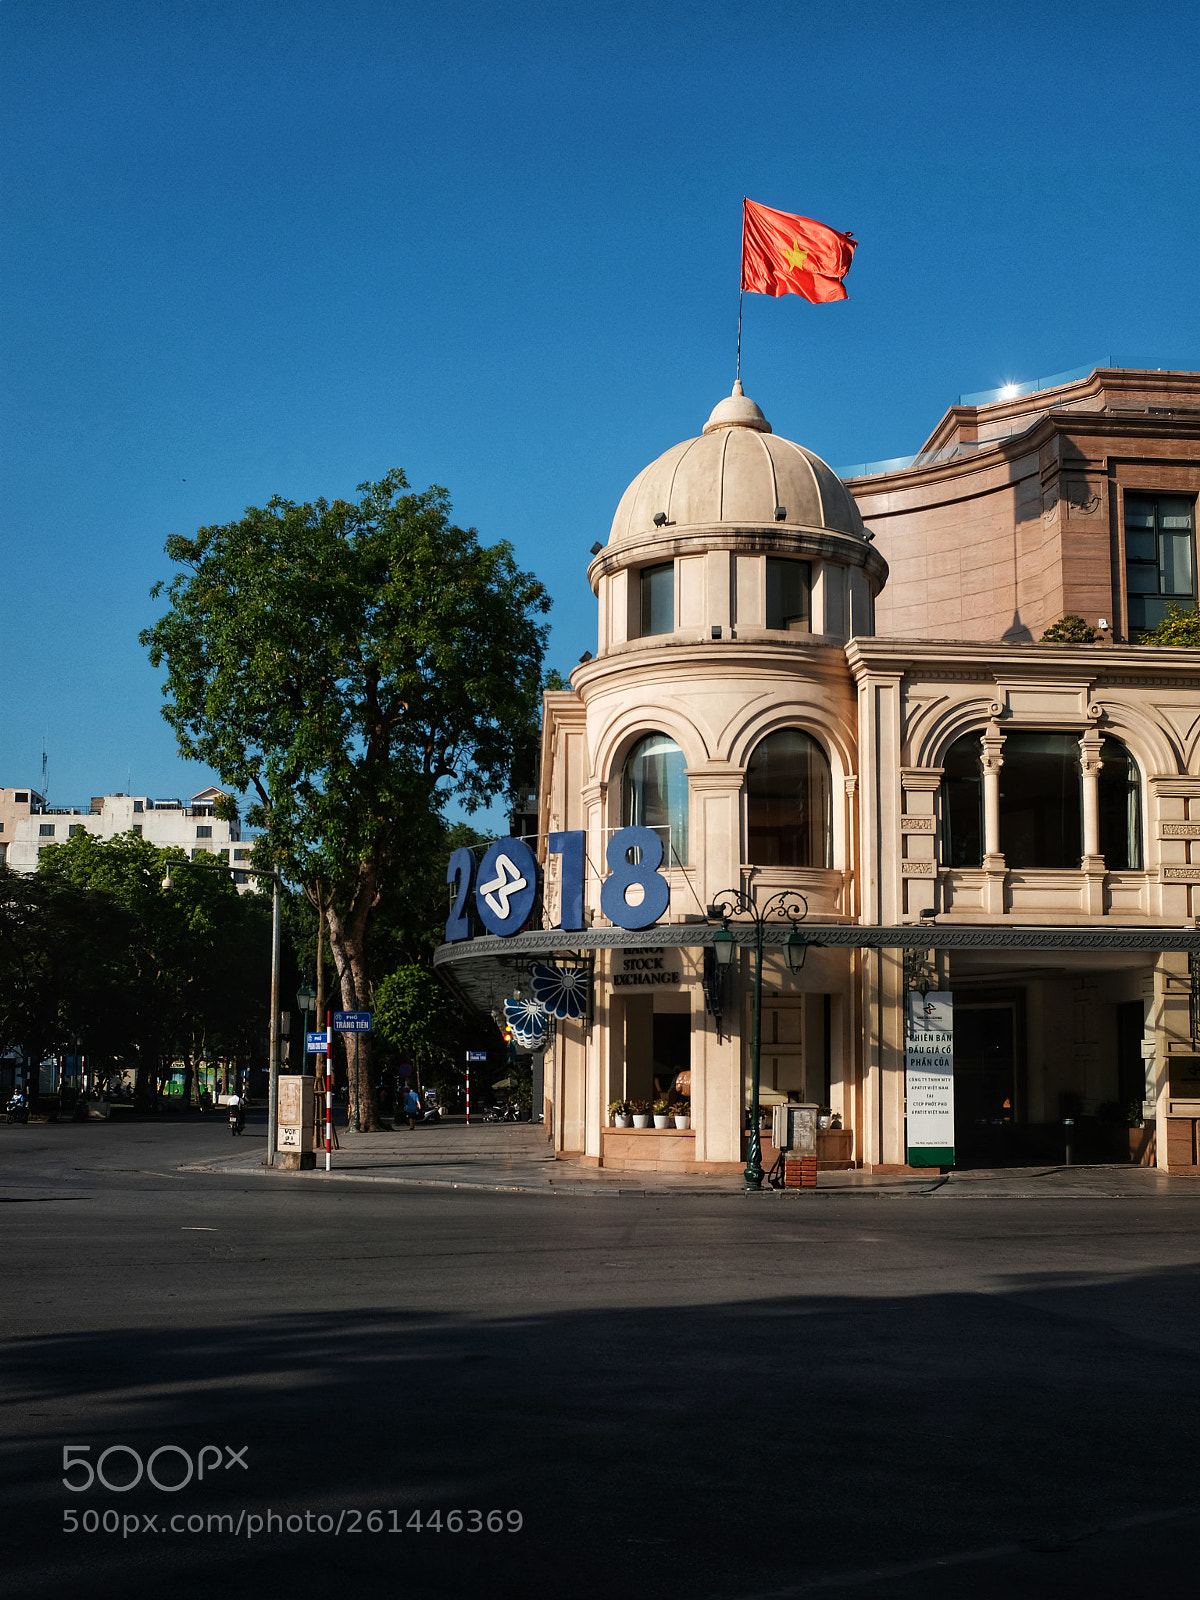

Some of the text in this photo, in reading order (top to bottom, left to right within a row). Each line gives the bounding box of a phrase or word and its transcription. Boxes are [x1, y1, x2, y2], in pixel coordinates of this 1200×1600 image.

[446, 825, 669, 942] 2018
[623, 957, 664, 971] STOCK
[613, 971, 680, 986] EXCHANGE
[335, 1020, 355, 1029] TRÀNG
[909, 1033, 934, 1042] PHIÊN
[926, 1044, 940, 1054] GIÁ
